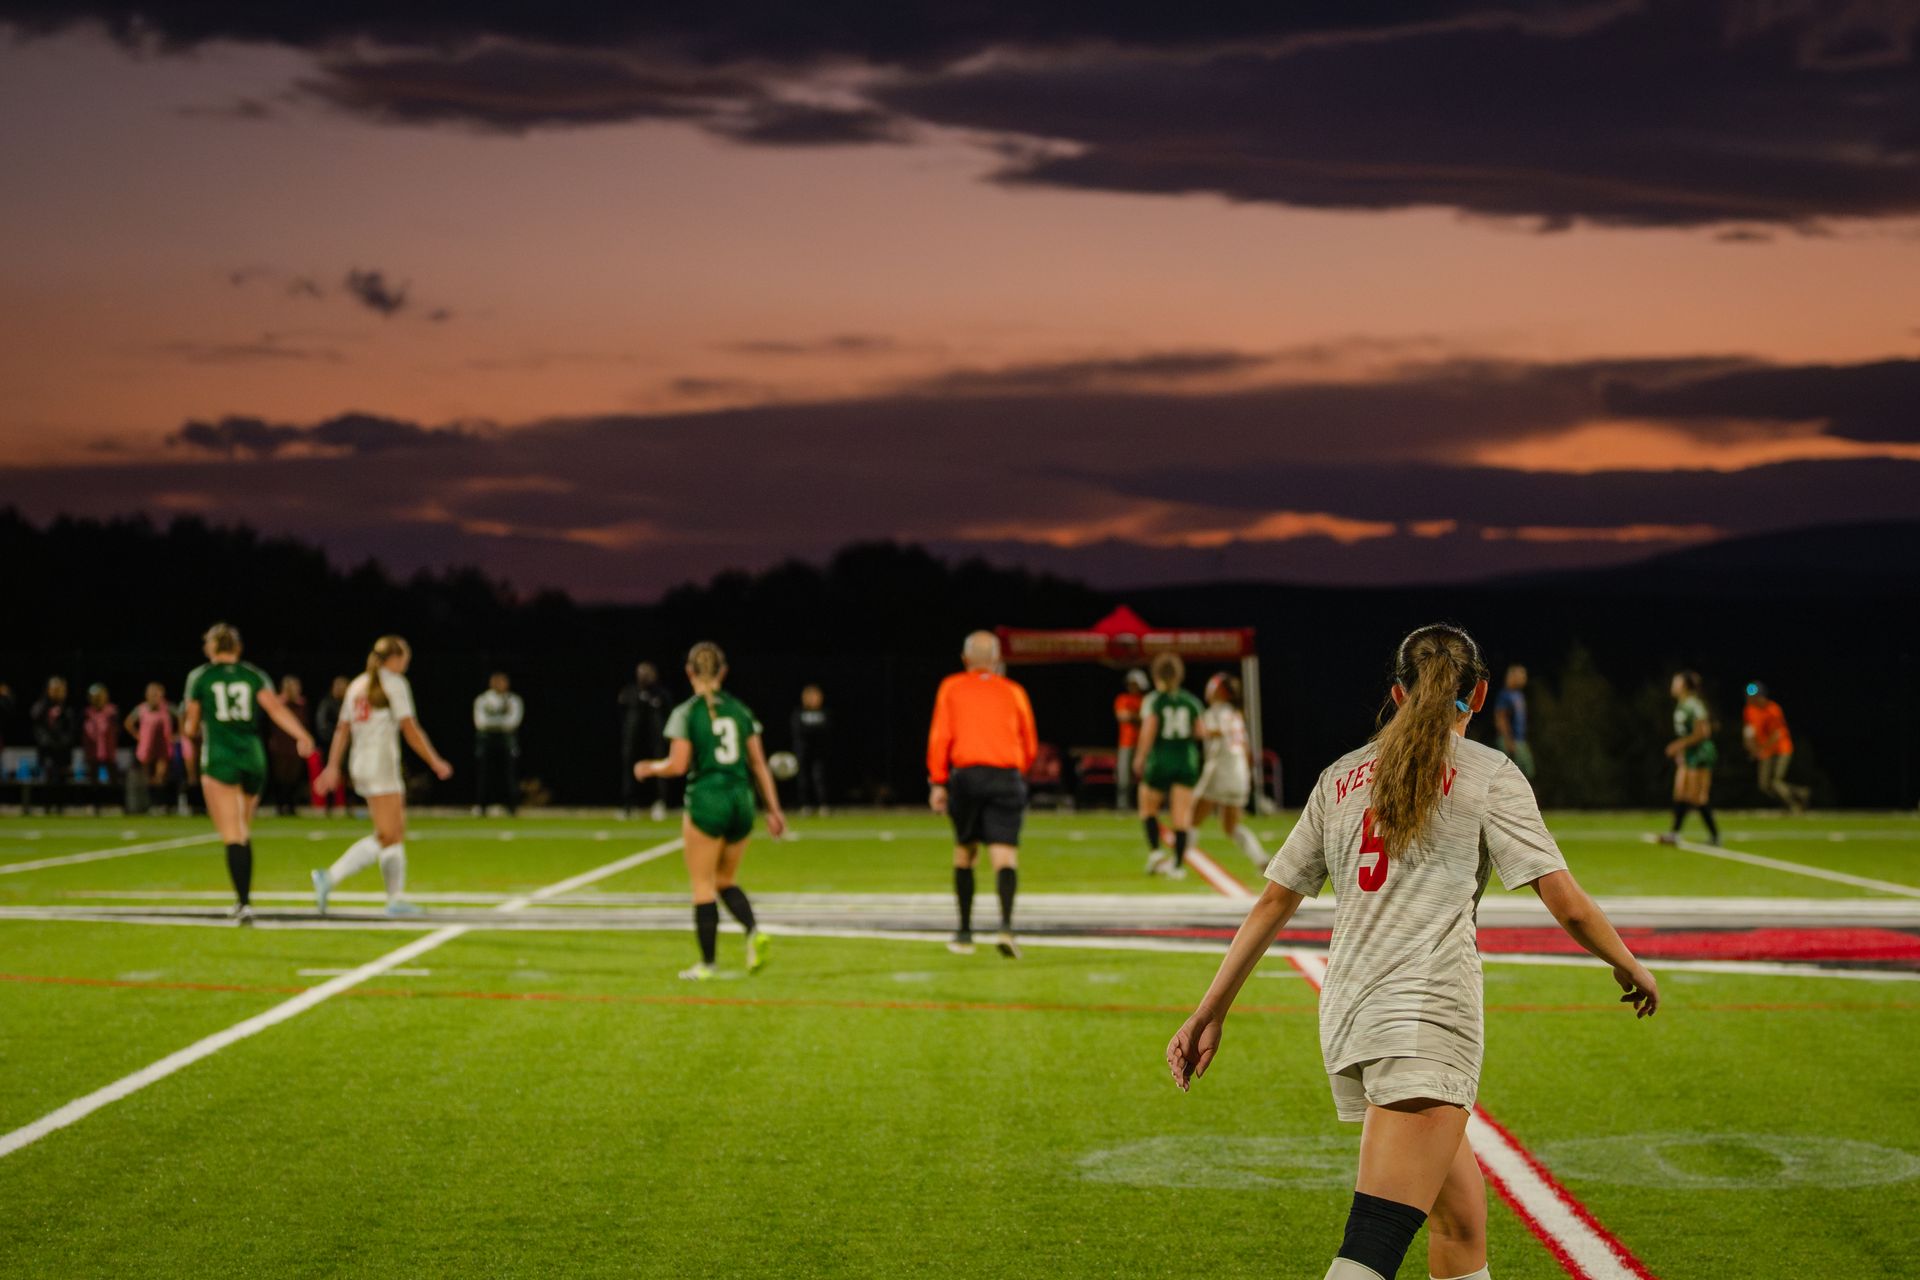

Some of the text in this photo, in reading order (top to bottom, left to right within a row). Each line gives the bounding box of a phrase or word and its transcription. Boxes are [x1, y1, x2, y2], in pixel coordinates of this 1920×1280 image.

[211, 681, 252, 722] 13
[712, 717, 739, 765] 3
[1335, 758, 1458, 805] WESN
[1357, 806, 1390, 892] 5
